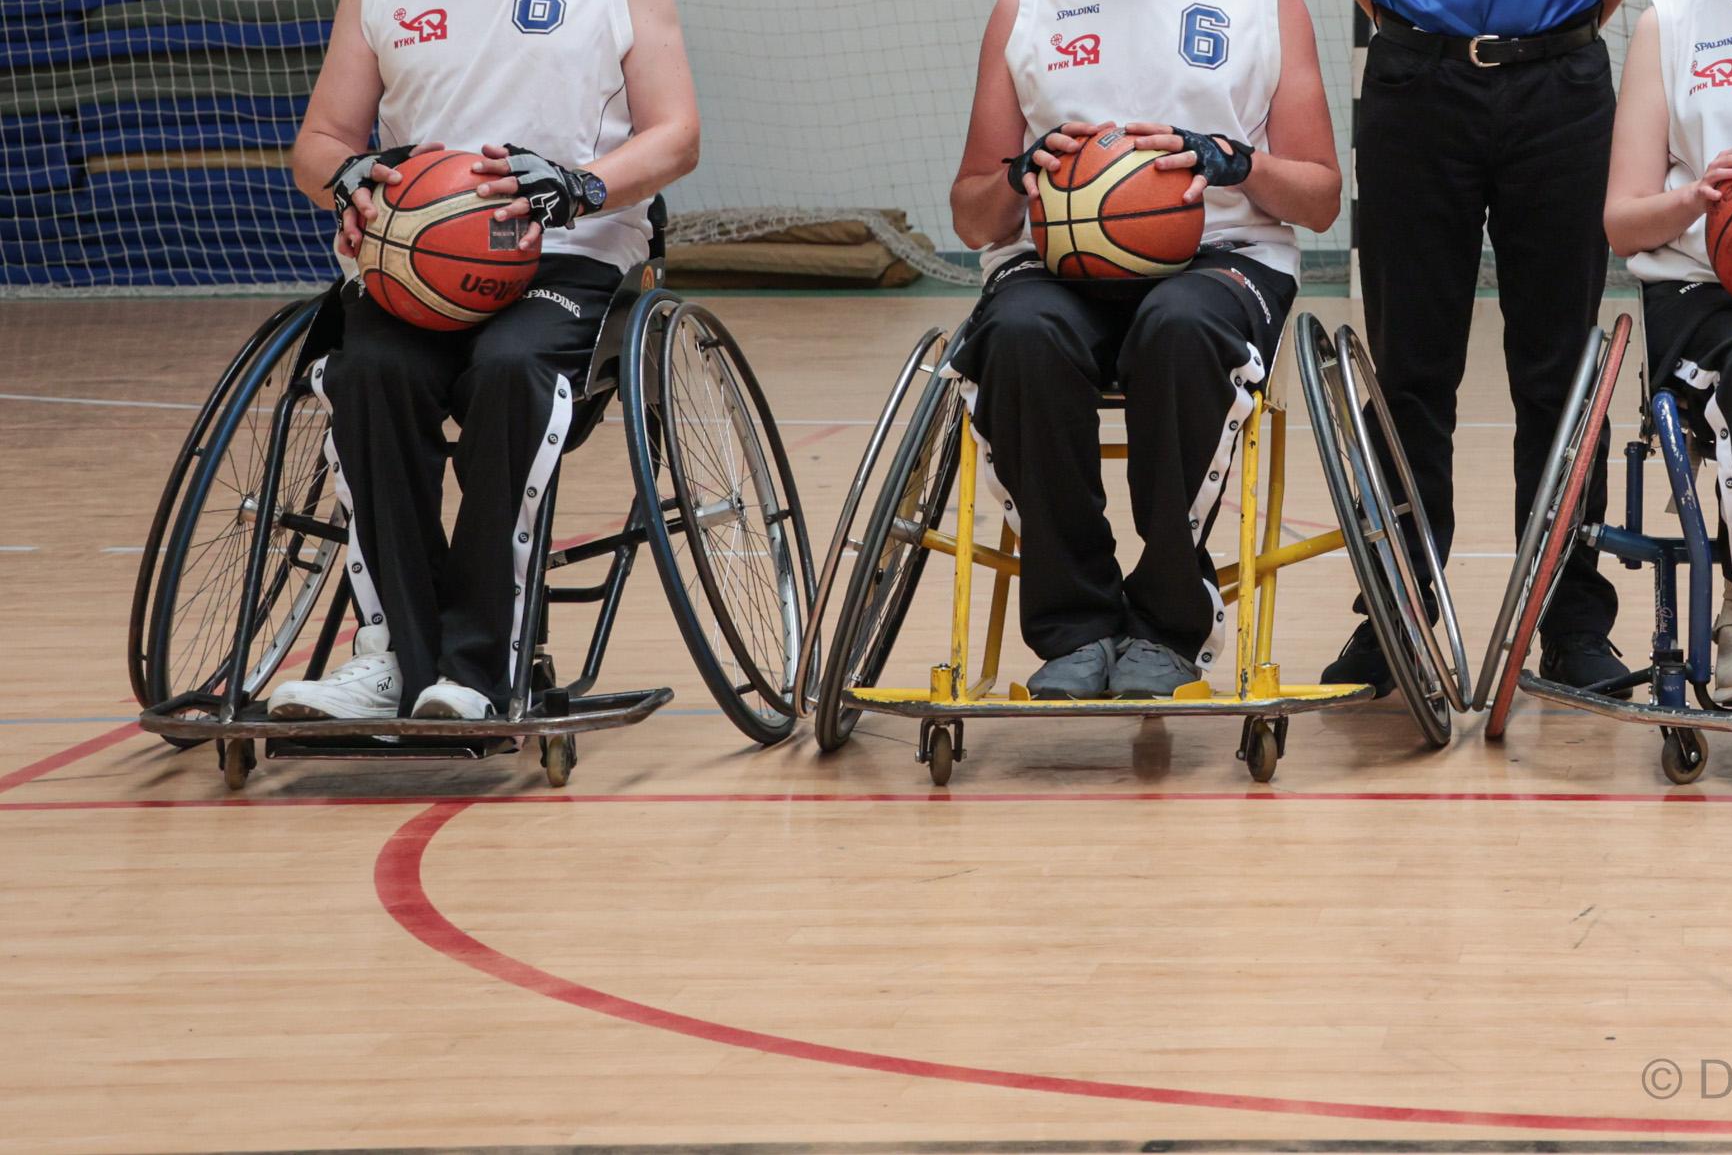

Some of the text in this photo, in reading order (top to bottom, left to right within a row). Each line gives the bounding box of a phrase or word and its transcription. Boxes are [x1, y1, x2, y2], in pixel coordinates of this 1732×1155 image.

[1056, 3, 1100, 21] SPALDING
[393, 36, 416, 49] NYKK
[1179, 2, 1231, 70] 6
[523, 288, 581, 318] PALDING
